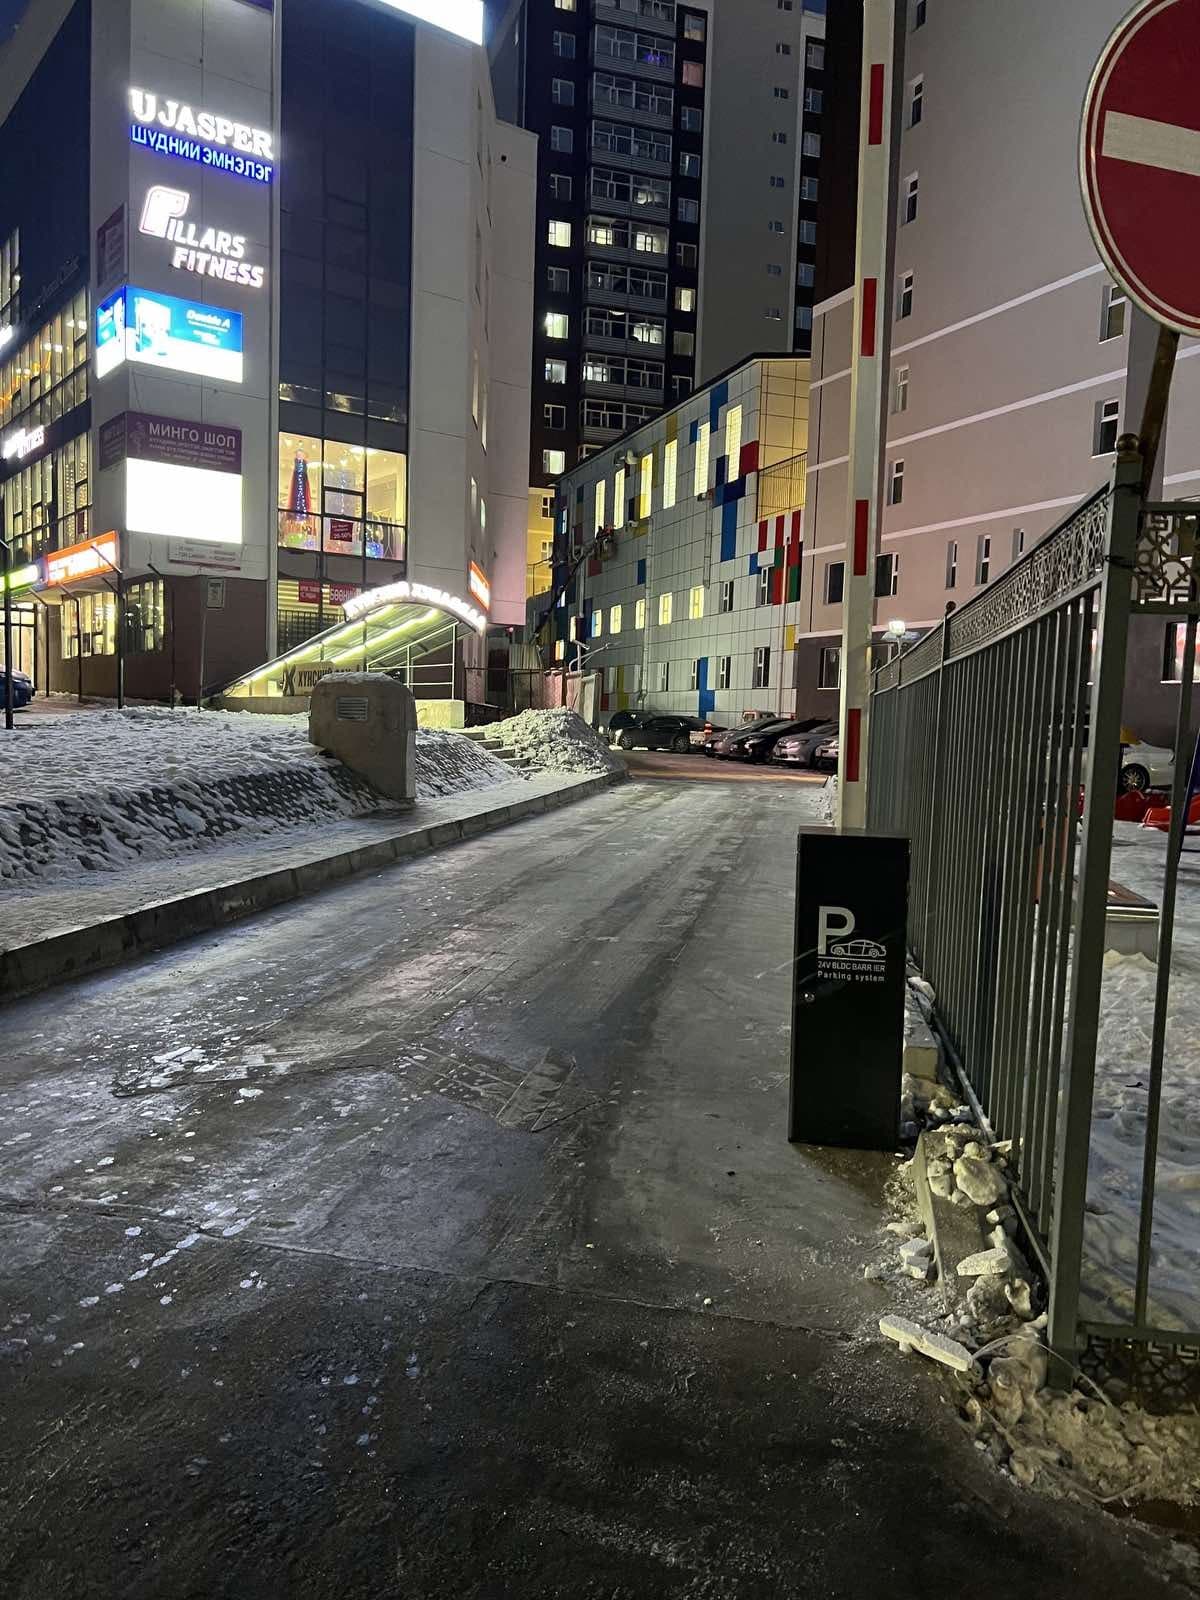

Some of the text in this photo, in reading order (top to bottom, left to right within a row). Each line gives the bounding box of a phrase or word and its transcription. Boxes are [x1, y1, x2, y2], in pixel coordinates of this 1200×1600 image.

[202, 147, 273, 182] ЭМНЭЛЭГ
[172, 246, 265, 289] FITNESS
[148, 421, 199, 442] МИНГО
[204, 431, 236, 449] ШОП
[818, 905, 855, 955] P
[817, 960, 831, 969] 24V
[817, 970, 885, 983] Parking system
